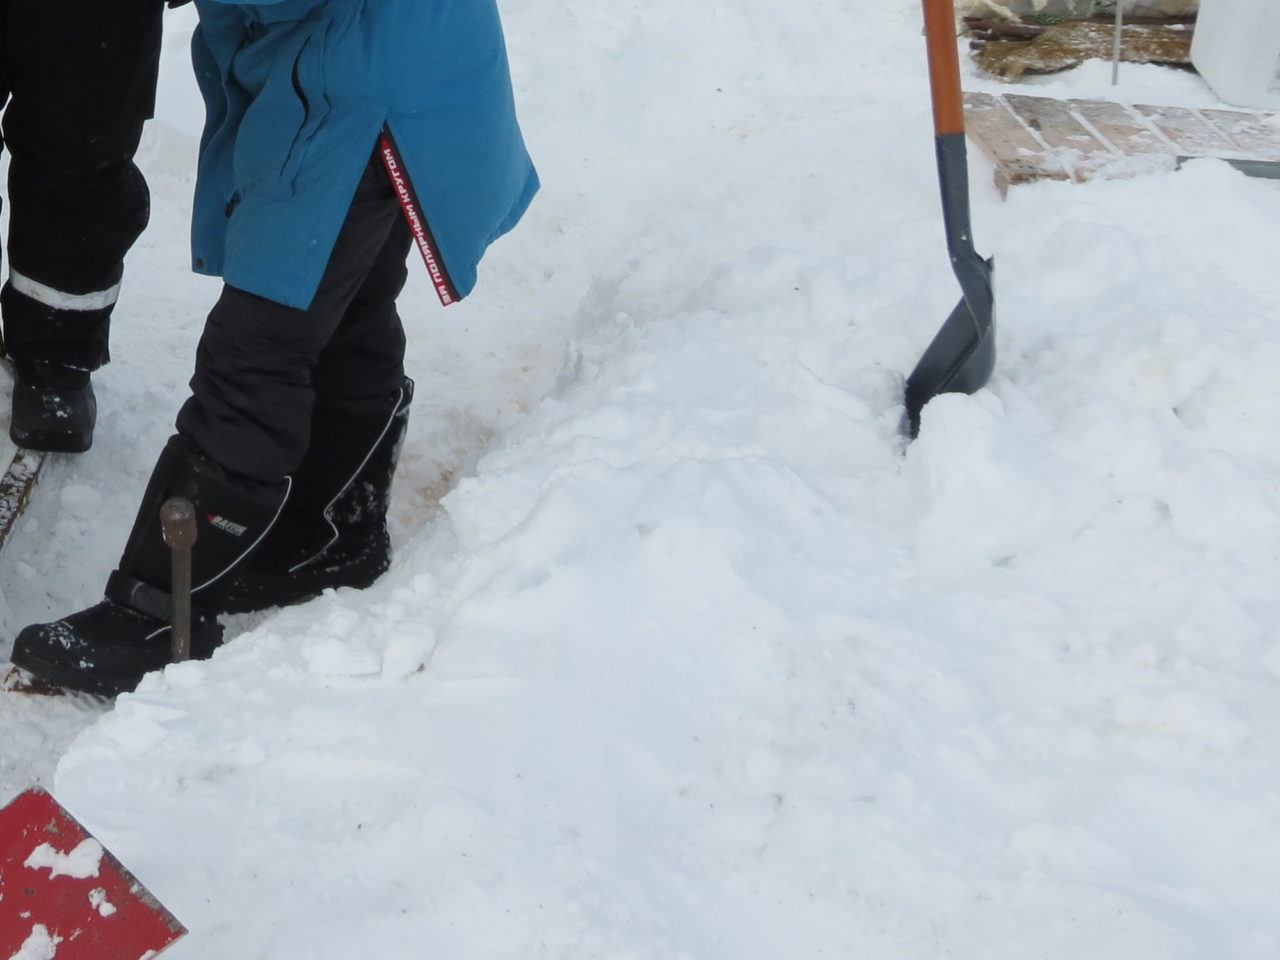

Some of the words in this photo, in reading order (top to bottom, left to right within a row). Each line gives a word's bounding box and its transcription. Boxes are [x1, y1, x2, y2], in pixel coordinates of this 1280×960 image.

[383, 148, 411, 203] КРУГОМ
[405, 204, 442, 283] ПОЛЯРНЫМ
[436, 283, 452, 305] ЗА
